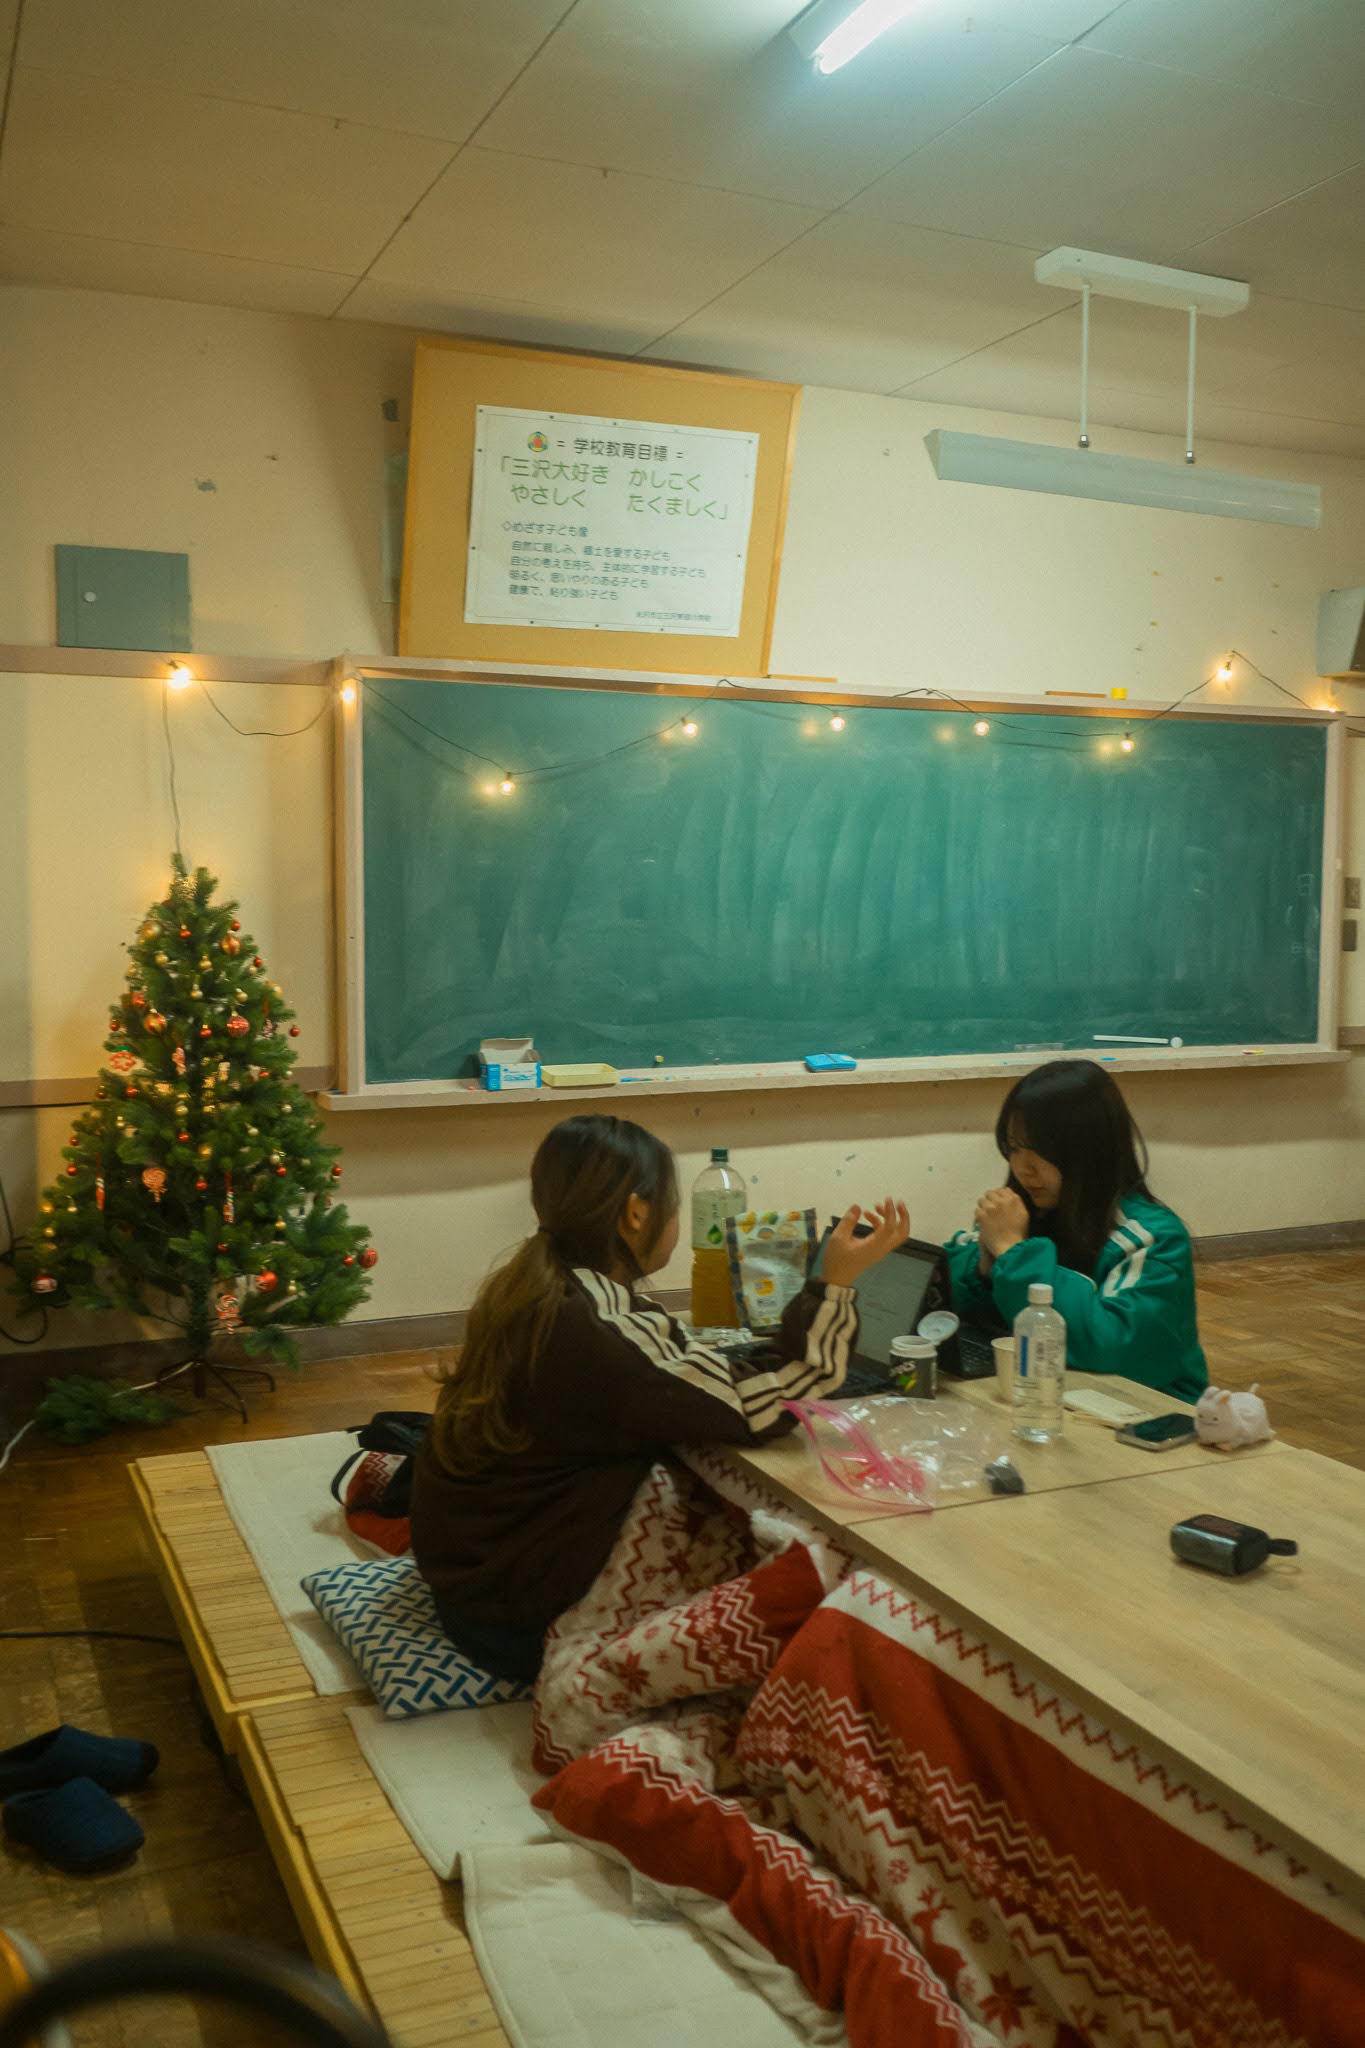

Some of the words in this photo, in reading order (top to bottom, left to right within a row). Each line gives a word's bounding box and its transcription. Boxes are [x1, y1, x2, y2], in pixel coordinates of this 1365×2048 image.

[573, 437, 668, 462] 学校教育目標
[501, 455, 609, 485] 「三沢大好き
[629, 468, 702, 493] かしこく
[511, 483, 587, 508] やさしく
[626, 494, 729, 521] たくましく」
